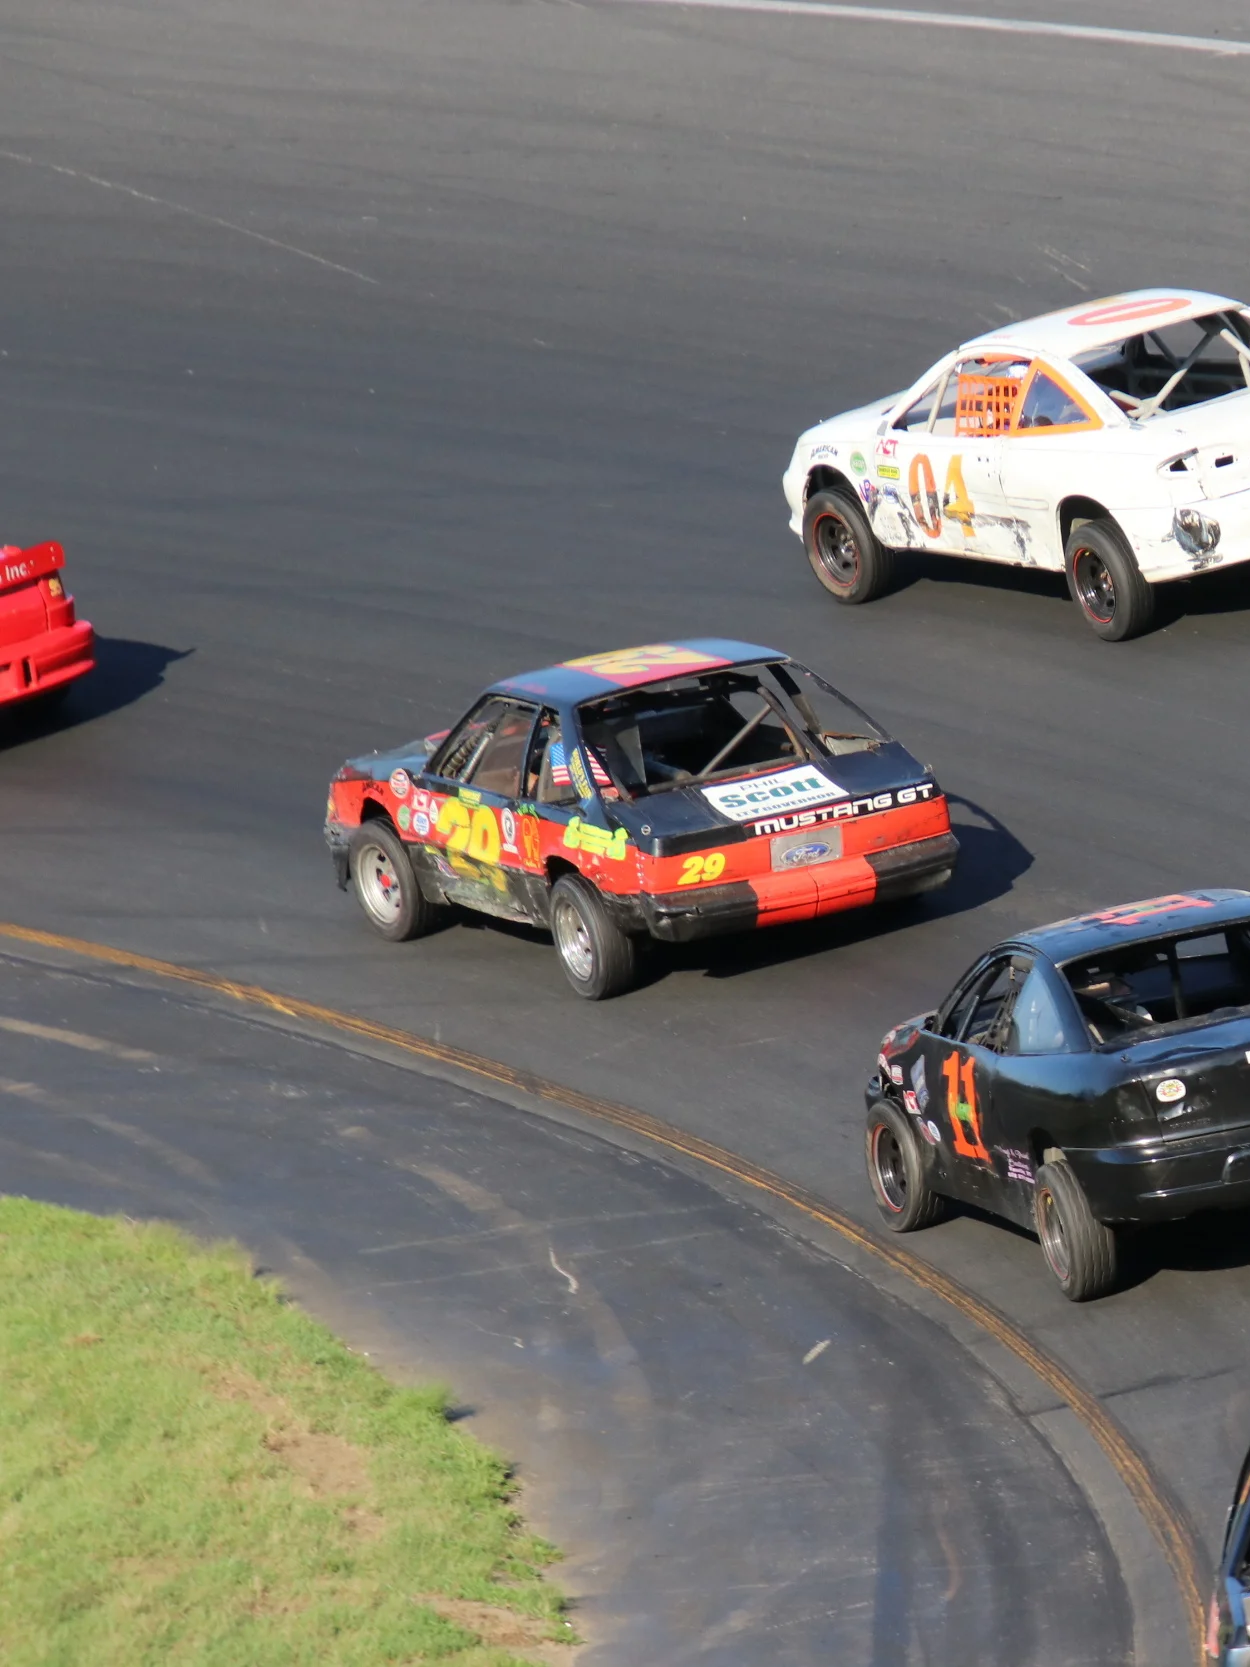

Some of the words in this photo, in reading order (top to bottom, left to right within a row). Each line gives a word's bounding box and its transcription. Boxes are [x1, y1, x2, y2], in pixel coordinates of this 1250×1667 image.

[908, 453, 977, 539] 04
[740, 777, 785, 792] PHIL
[755, 796, 892, 836] MUSTANG
[897, 783, 934, 804] GT
[762, 791, 836, 812] GOVERNOR
[677, 852, 726, 885] 29
[793, 846, 822, 863] Ford
[942, 1051, 993, 1164] 11
